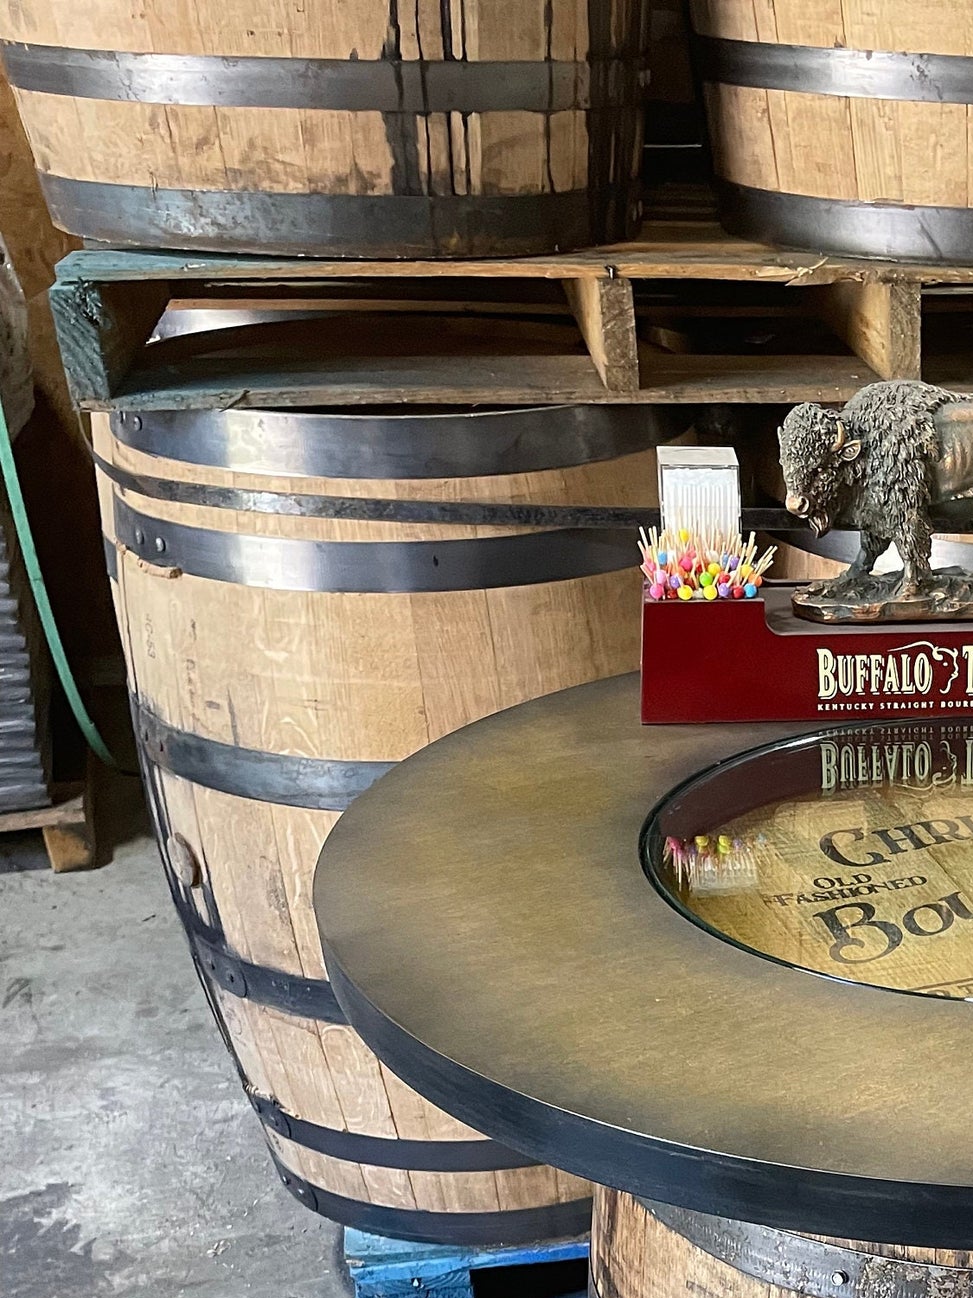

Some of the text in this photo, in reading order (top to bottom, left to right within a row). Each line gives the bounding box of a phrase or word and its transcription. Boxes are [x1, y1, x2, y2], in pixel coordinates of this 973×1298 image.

[816, 648, 933, 700] BUFFALO
[817, 702, 875, 712] KENTUCKY
[880, 700, 935, 711] STRAIGHT
[771, 875, 929, 907] FASHIONED
[812, 873, 873, 890] OLD
